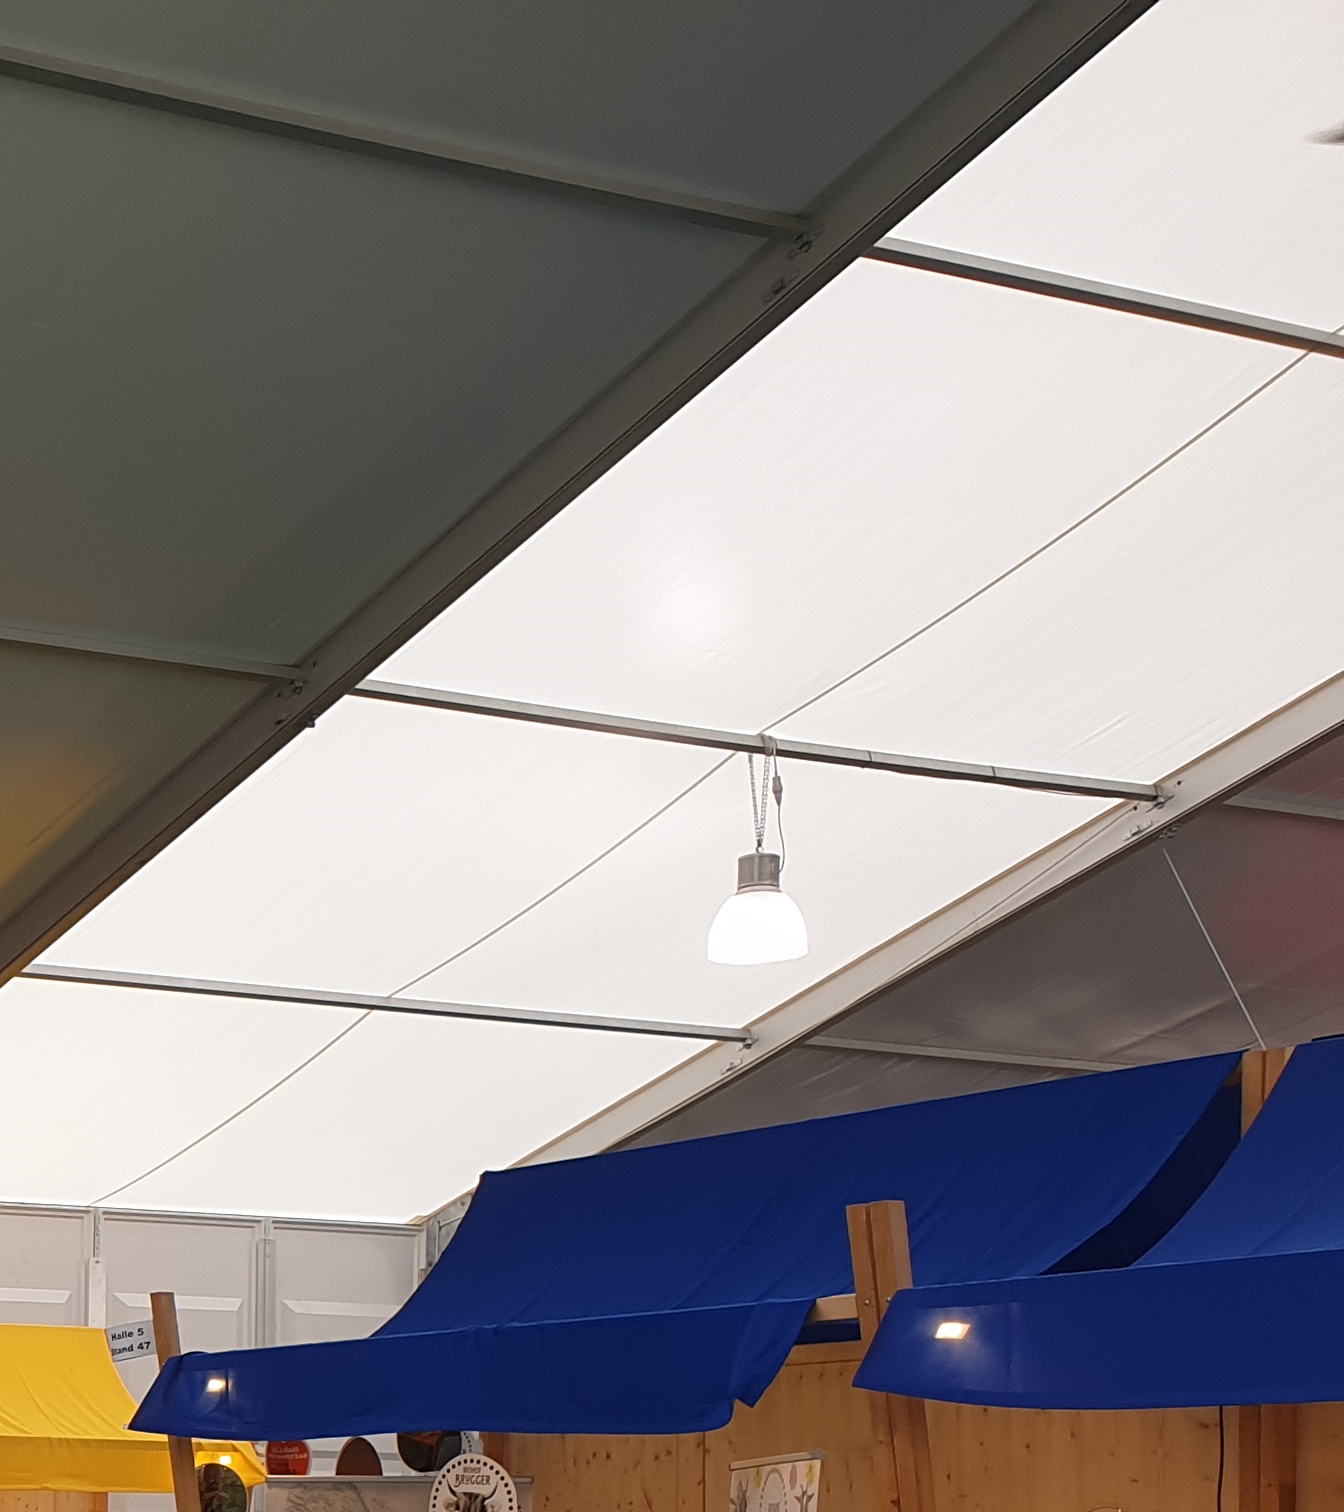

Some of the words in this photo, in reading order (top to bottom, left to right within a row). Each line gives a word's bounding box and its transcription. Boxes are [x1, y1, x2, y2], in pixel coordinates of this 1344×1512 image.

[137, 1327, 144, 1336] 5
[137, 1341, 151, 1350] 47
[453, 1474, 491, 1487] BRUGGER
